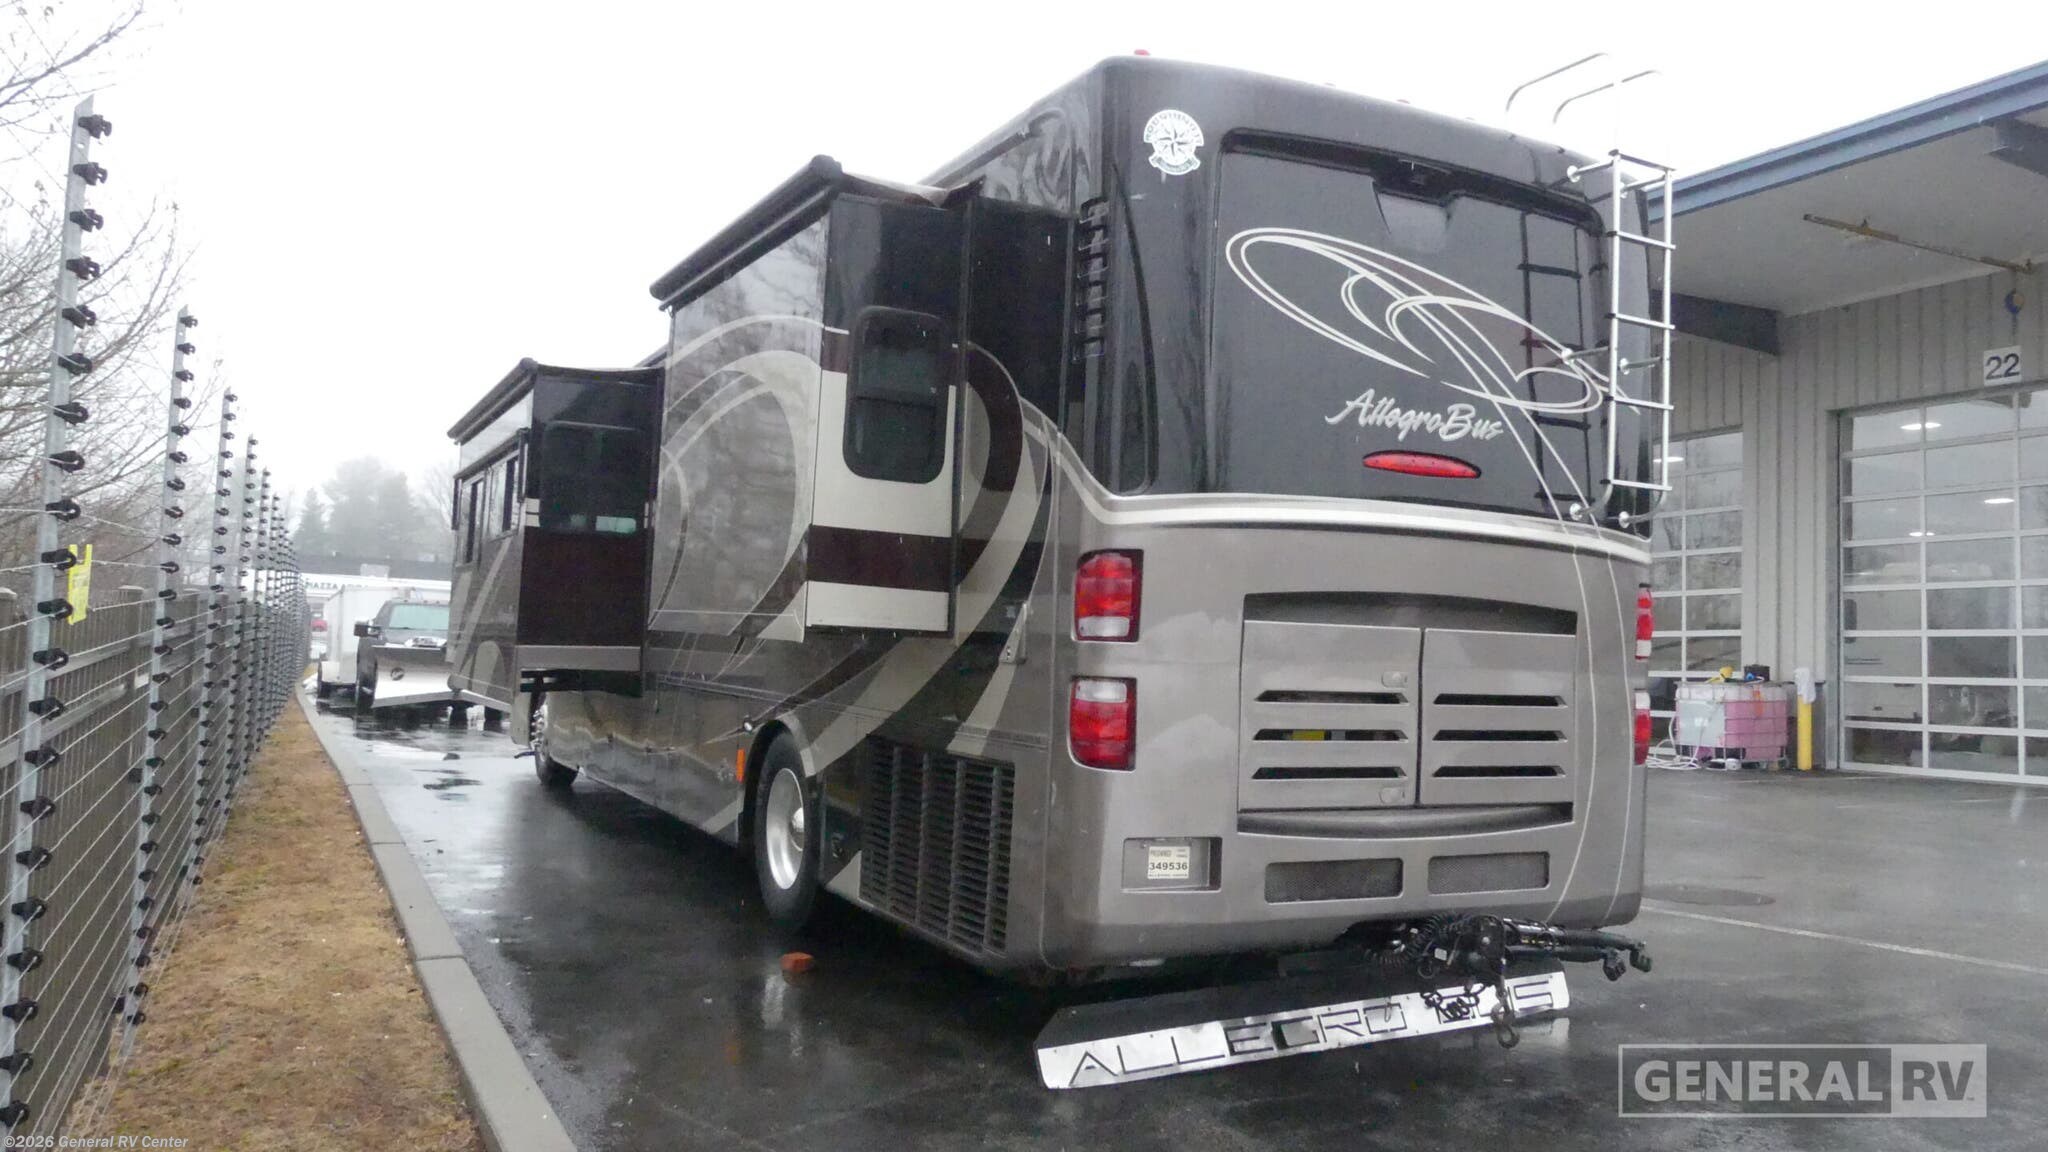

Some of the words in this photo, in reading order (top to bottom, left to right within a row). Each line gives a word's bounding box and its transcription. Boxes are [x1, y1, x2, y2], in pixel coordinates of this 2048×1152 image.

[1985, 353, 2020, 380] 22
[1149, 861, 1188, 871] 349536
[1068, 1003, 1408, 1086] ALLEGRO
